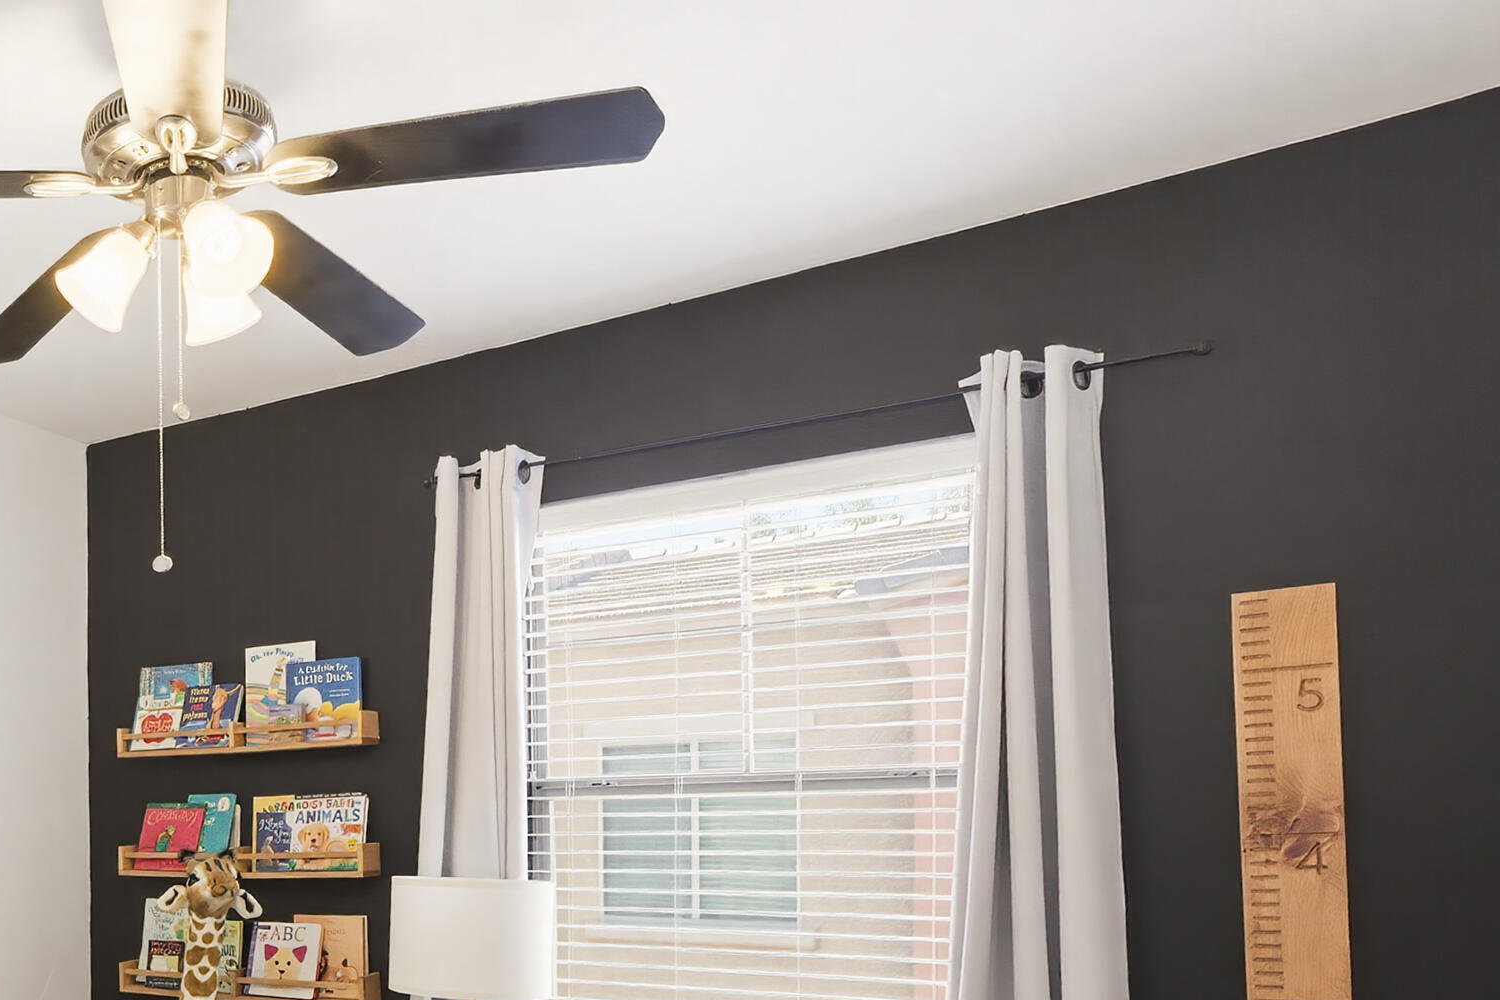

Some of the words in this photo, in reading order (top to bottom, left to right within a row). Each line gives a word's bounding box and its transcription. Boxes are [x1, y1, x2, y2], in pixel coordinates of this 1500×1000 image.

[326, 671, 354, 683] Duck
[1297, 678, 1325, 711] 5
[295, 809, 360, 824] ANIMALS
[1295, 841, 1329, 875] 4
[270, 926, 307, 942] ABC
